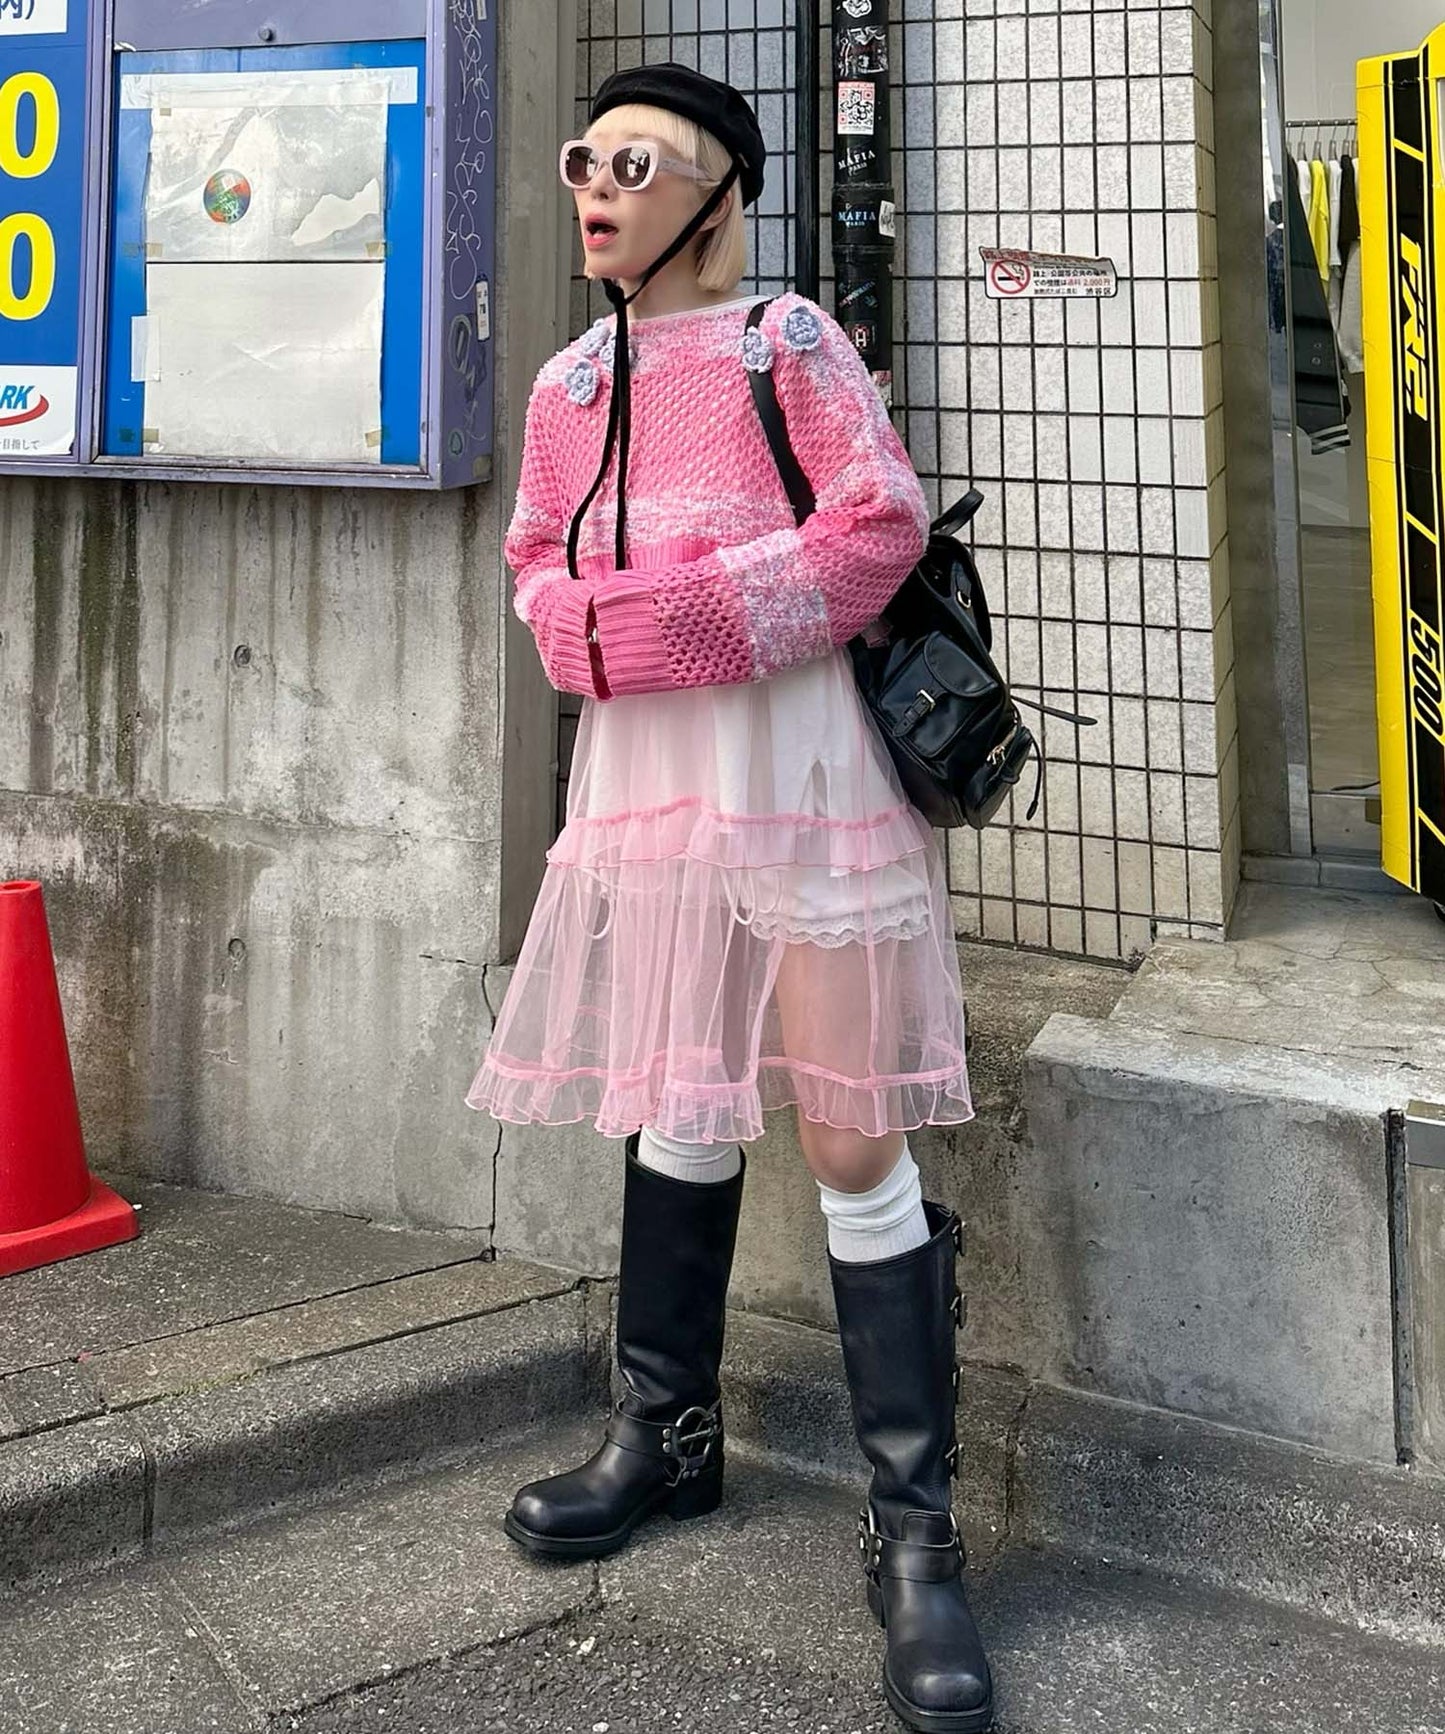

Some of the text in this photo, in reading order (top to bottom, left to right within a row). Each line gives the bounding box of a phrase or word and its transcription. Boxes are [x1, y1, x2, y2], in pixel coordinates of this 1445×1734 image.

[838, 149, 876, 170] MAFIA
[838, 211, 877, 221] MAFIA
[0, 438, 40, 450] 目指して
[1410, 616, 1444, 736] 500
